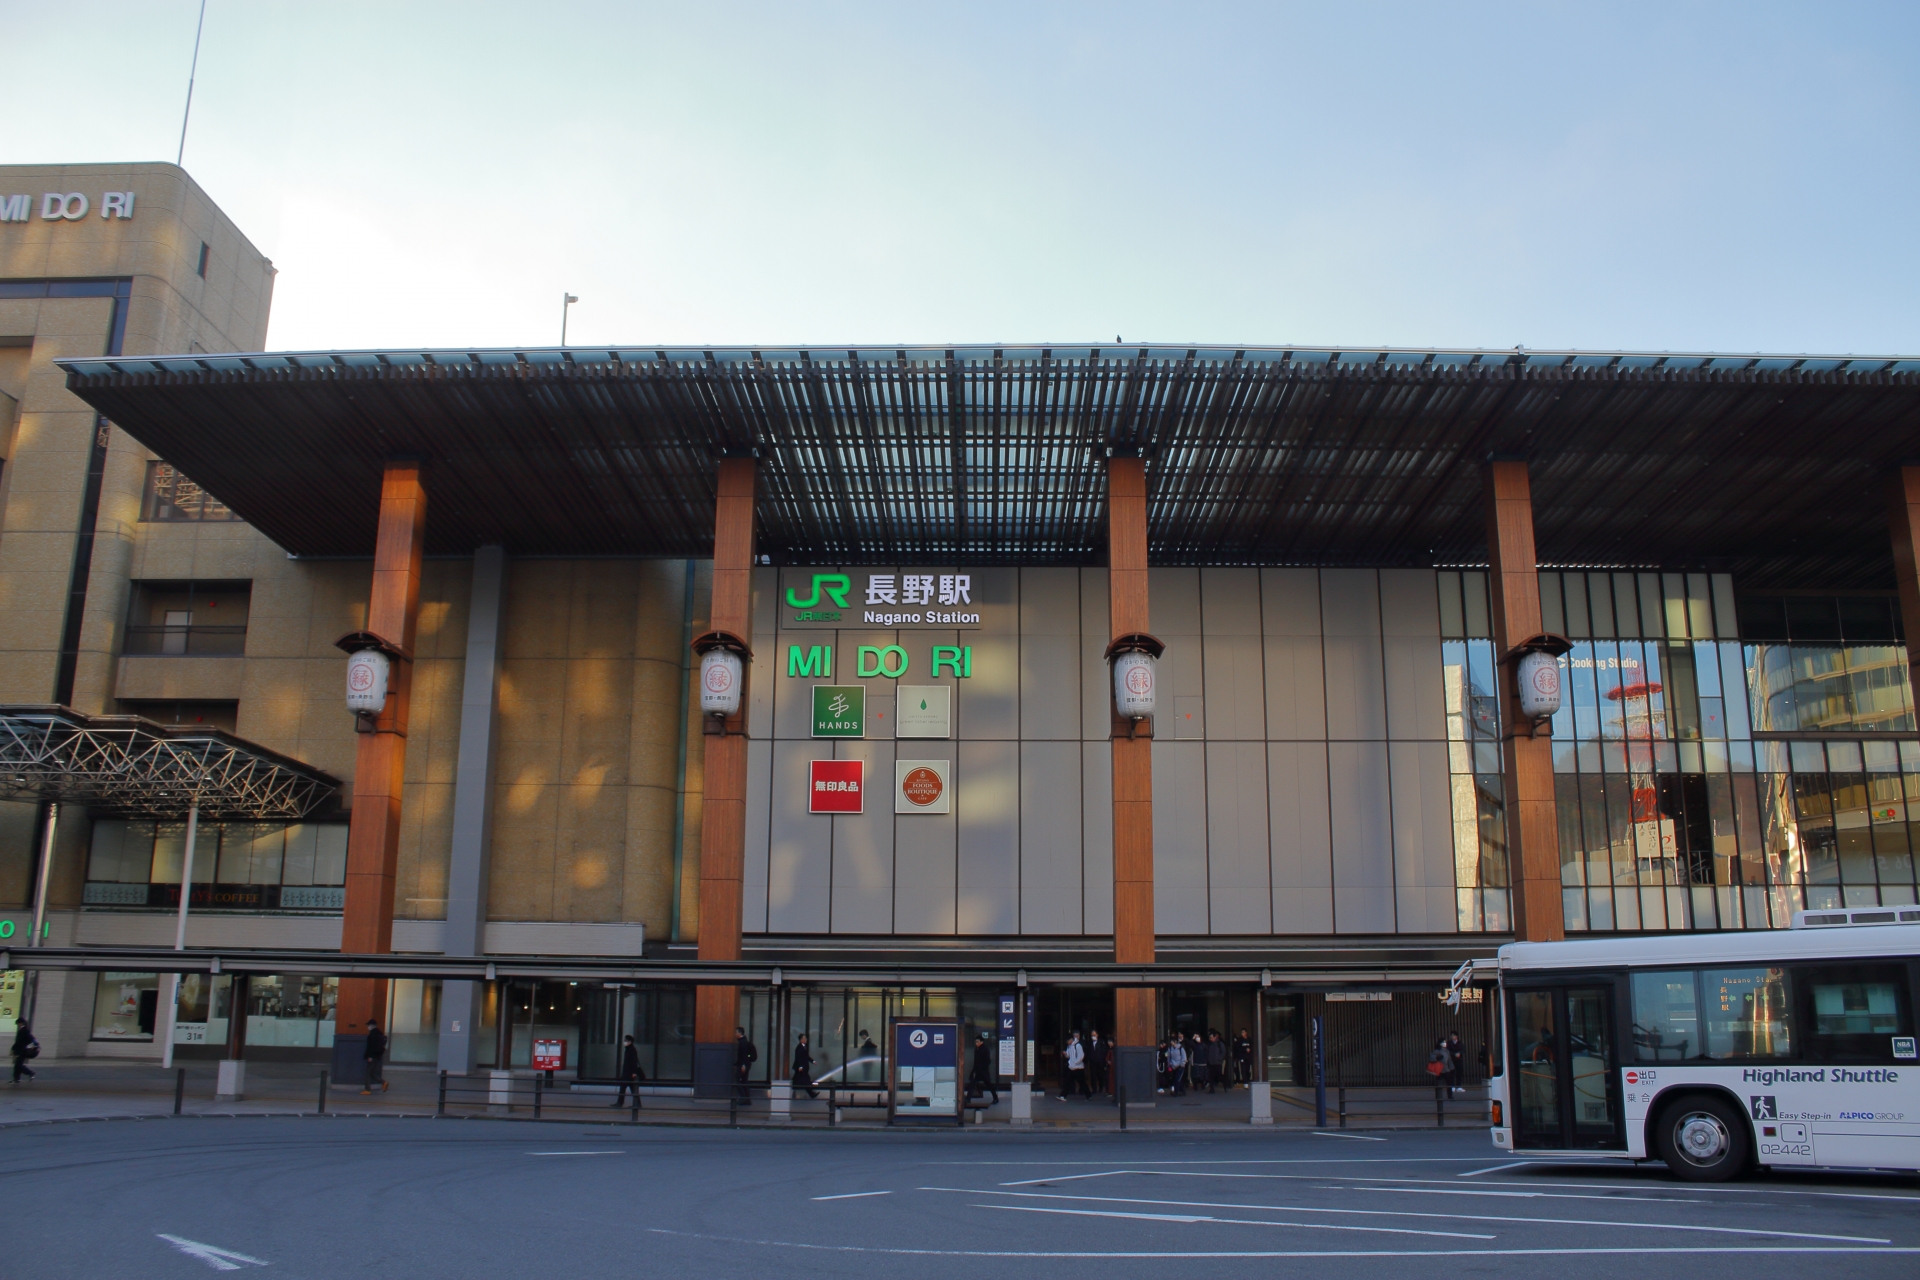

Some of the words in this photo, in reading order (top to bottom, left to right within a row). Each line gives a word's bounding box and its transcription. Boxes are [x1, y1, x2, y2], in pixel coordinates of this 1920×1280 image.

[41, 192, 89, 221] DO
[101, 192, 135, 220] RI
[785, 573, 851, 609] JR
[864, 574, 972, 606] 長野駅
[795, 611, 842, 622] JR東日本
[863, 611, 921, 626] Nagano
[925, 610, 980, 624] Station
[788, 645, 832, 678] MI
[857, 644, 909, 678] DO
[932, 645, 972, 678] RI
[819, 721, 858, 730] HANDS
[815, 780, 859, 792] 無印良品
[215, 893, 260, 903] COFFEE
[913, 1032, 924, 1045] 4
[1639, 1070, 1656, 1079] 出口
[1743, 1069, 1825, 1086] Highland
[1831, 1068, 1899, 1083] Shuttle
[1779, 1112, 1798, 1120] Easy
[1800, 1112, 1831, 1120] Step-in
[1760, 1144, 1811, 1156] 02442
